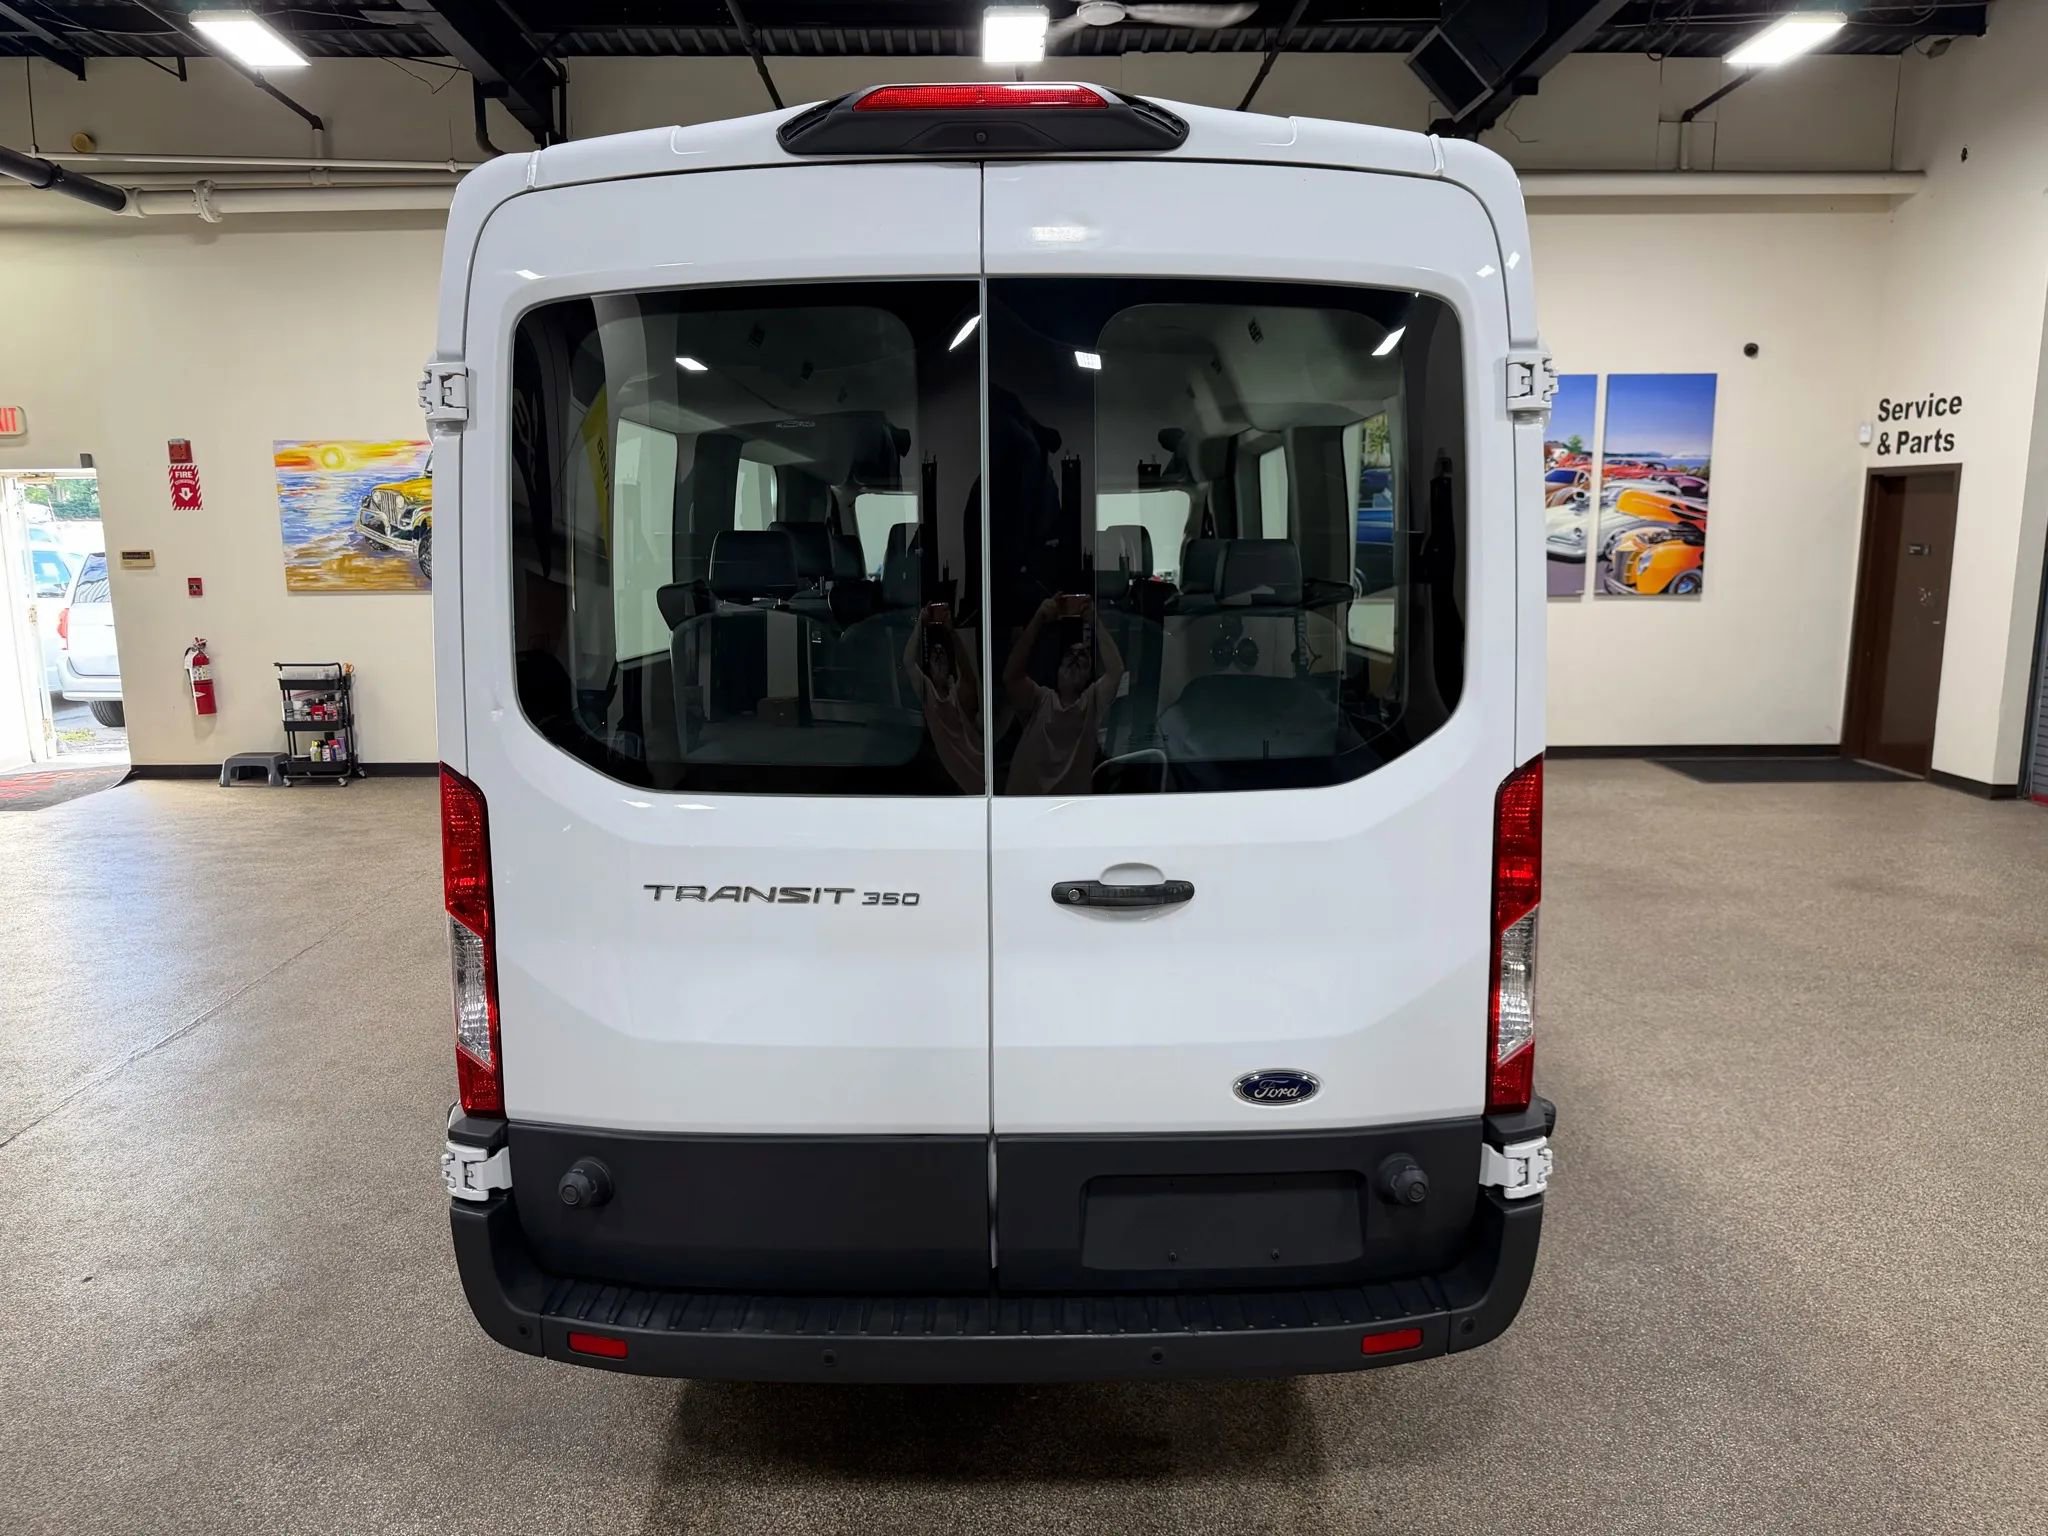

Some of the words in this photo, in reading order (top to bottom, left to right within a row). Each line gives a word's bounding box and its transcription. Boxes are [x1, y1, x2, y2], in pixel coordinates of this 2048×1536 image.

[1878, 392, 1963, 422] Service
[1877, 431, 1891, 456] &
[1895, 428, 1955, 455] Parts
[174, 471, 194, 479] FIRE
[643, 884, 856, 905] TRANSIT
[862, 891, 920, 906] 350
[1253, 1079, 1302, 1099] Ford
